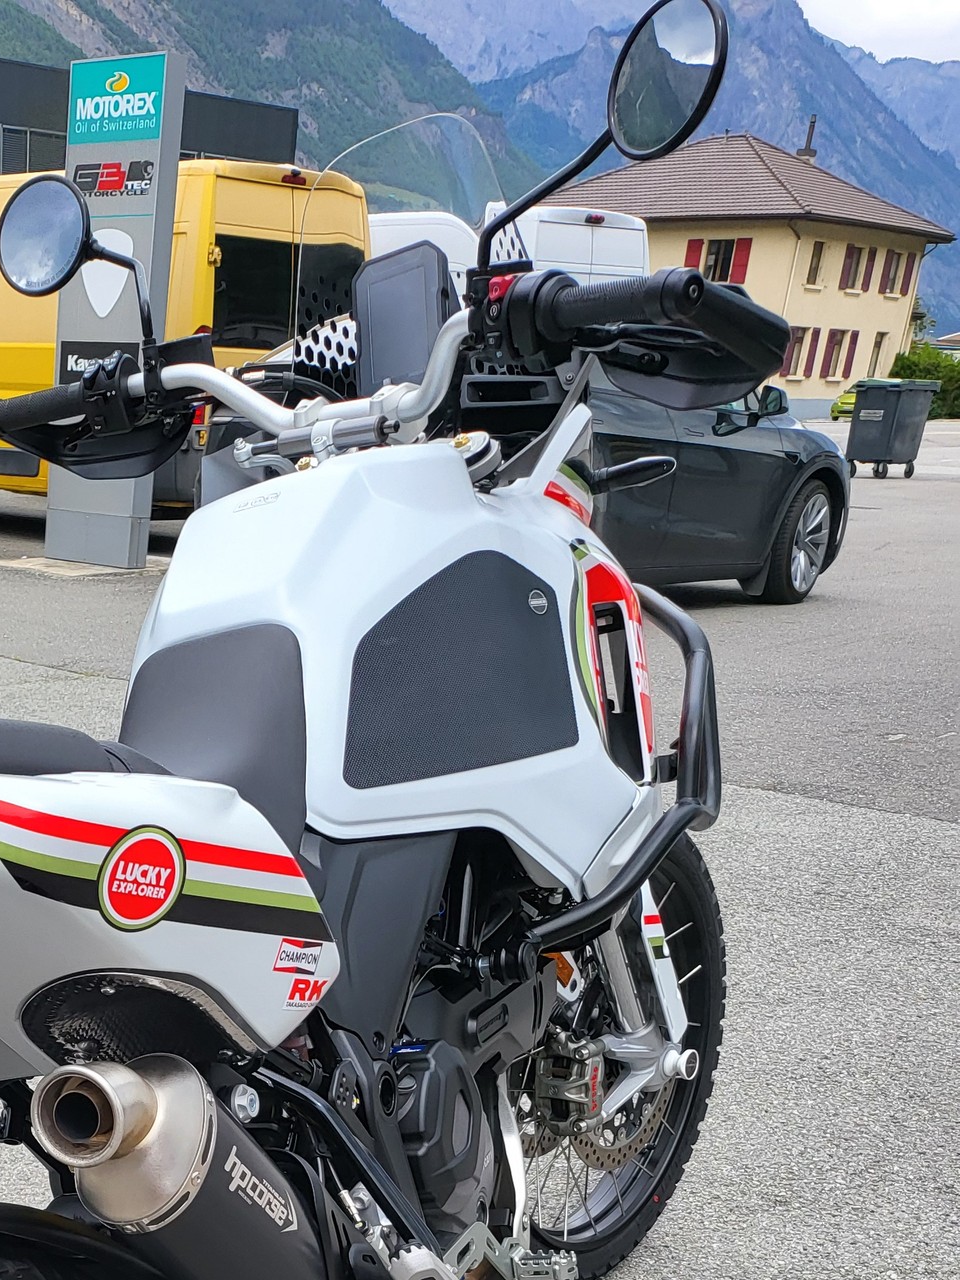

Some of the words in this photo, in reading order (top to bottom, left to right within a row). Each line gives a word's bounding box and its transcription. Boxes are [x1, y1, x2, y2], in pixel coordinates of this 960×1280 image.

[76, 91, 156, 120] MOTOREX
[75, 121, 88, 134] Oil
[90, 120, 100, 132] of
[102, 117, 156, 131] Switzerland
[125, 180, 151, 189] TEC
[115, 860, 172, 887] LUCKY
[111, 880, 166, 900] EXPLORER
[279, 949, 319, 965] CHAMPION
[288, 978, 329, 1001] RK
